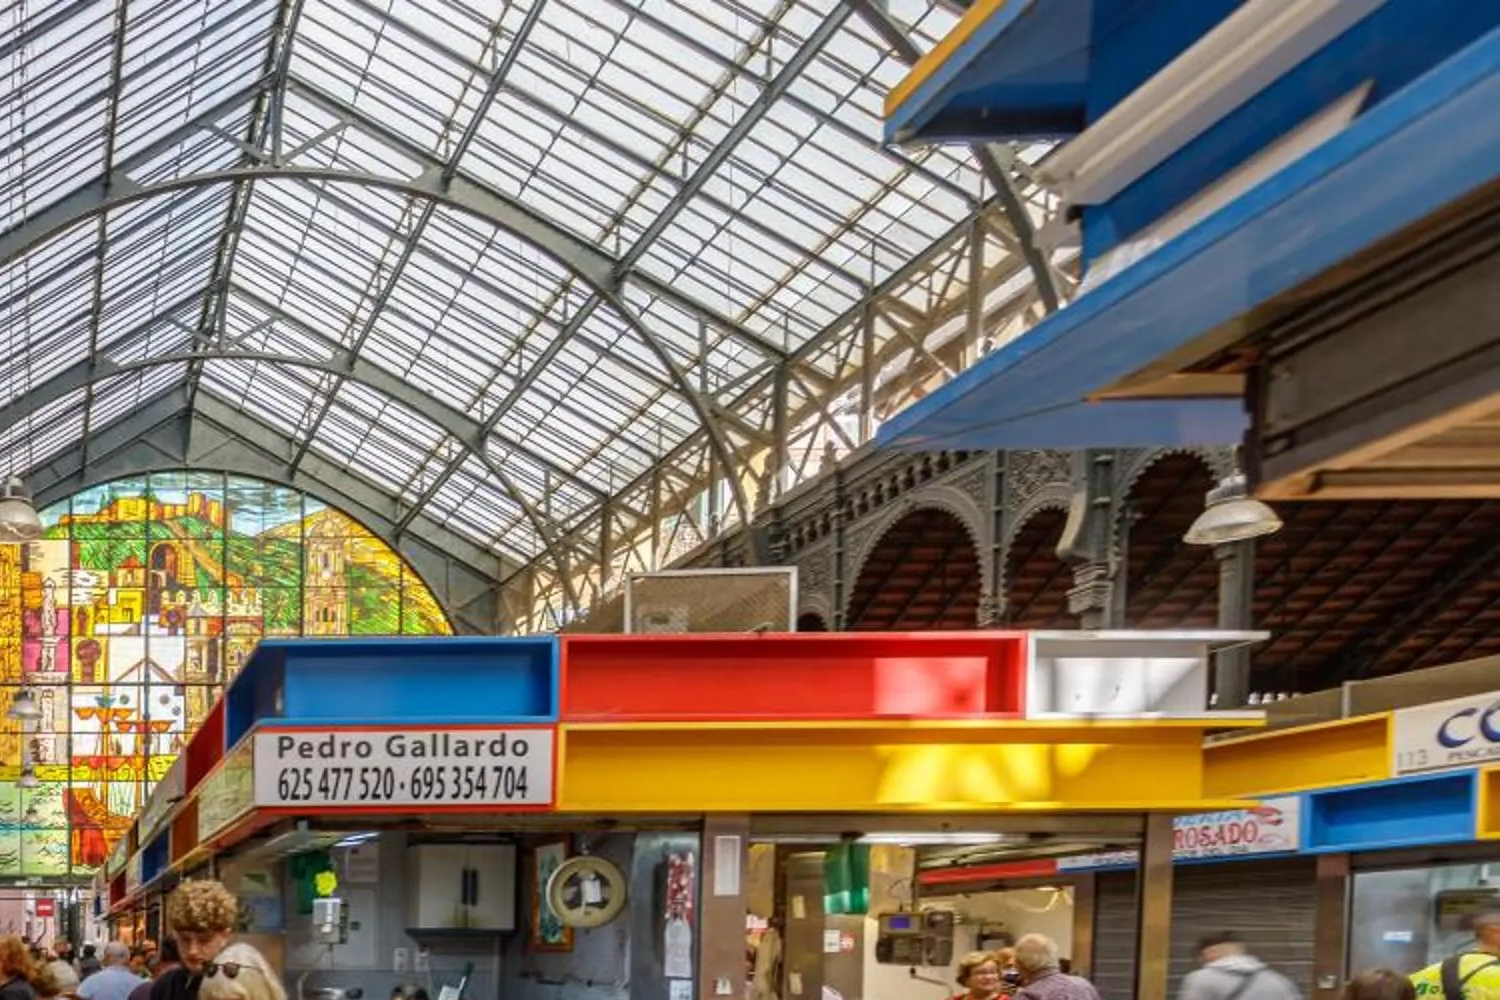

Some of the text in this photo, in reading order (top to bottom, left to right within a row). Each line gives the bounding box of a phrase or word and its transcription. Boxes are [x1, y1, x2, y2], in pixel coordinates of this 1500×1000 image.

[277, 733, 530, 759] Pedro Gallardo
[278, 767, 313, 801] 625
[317, 767, 354, 801] 477
[359, 767, 395, 800] 520
[410, 766, 445, 799] 695
[451, 766, 487, 799] 354
[492, 765, 528, 799] 704
